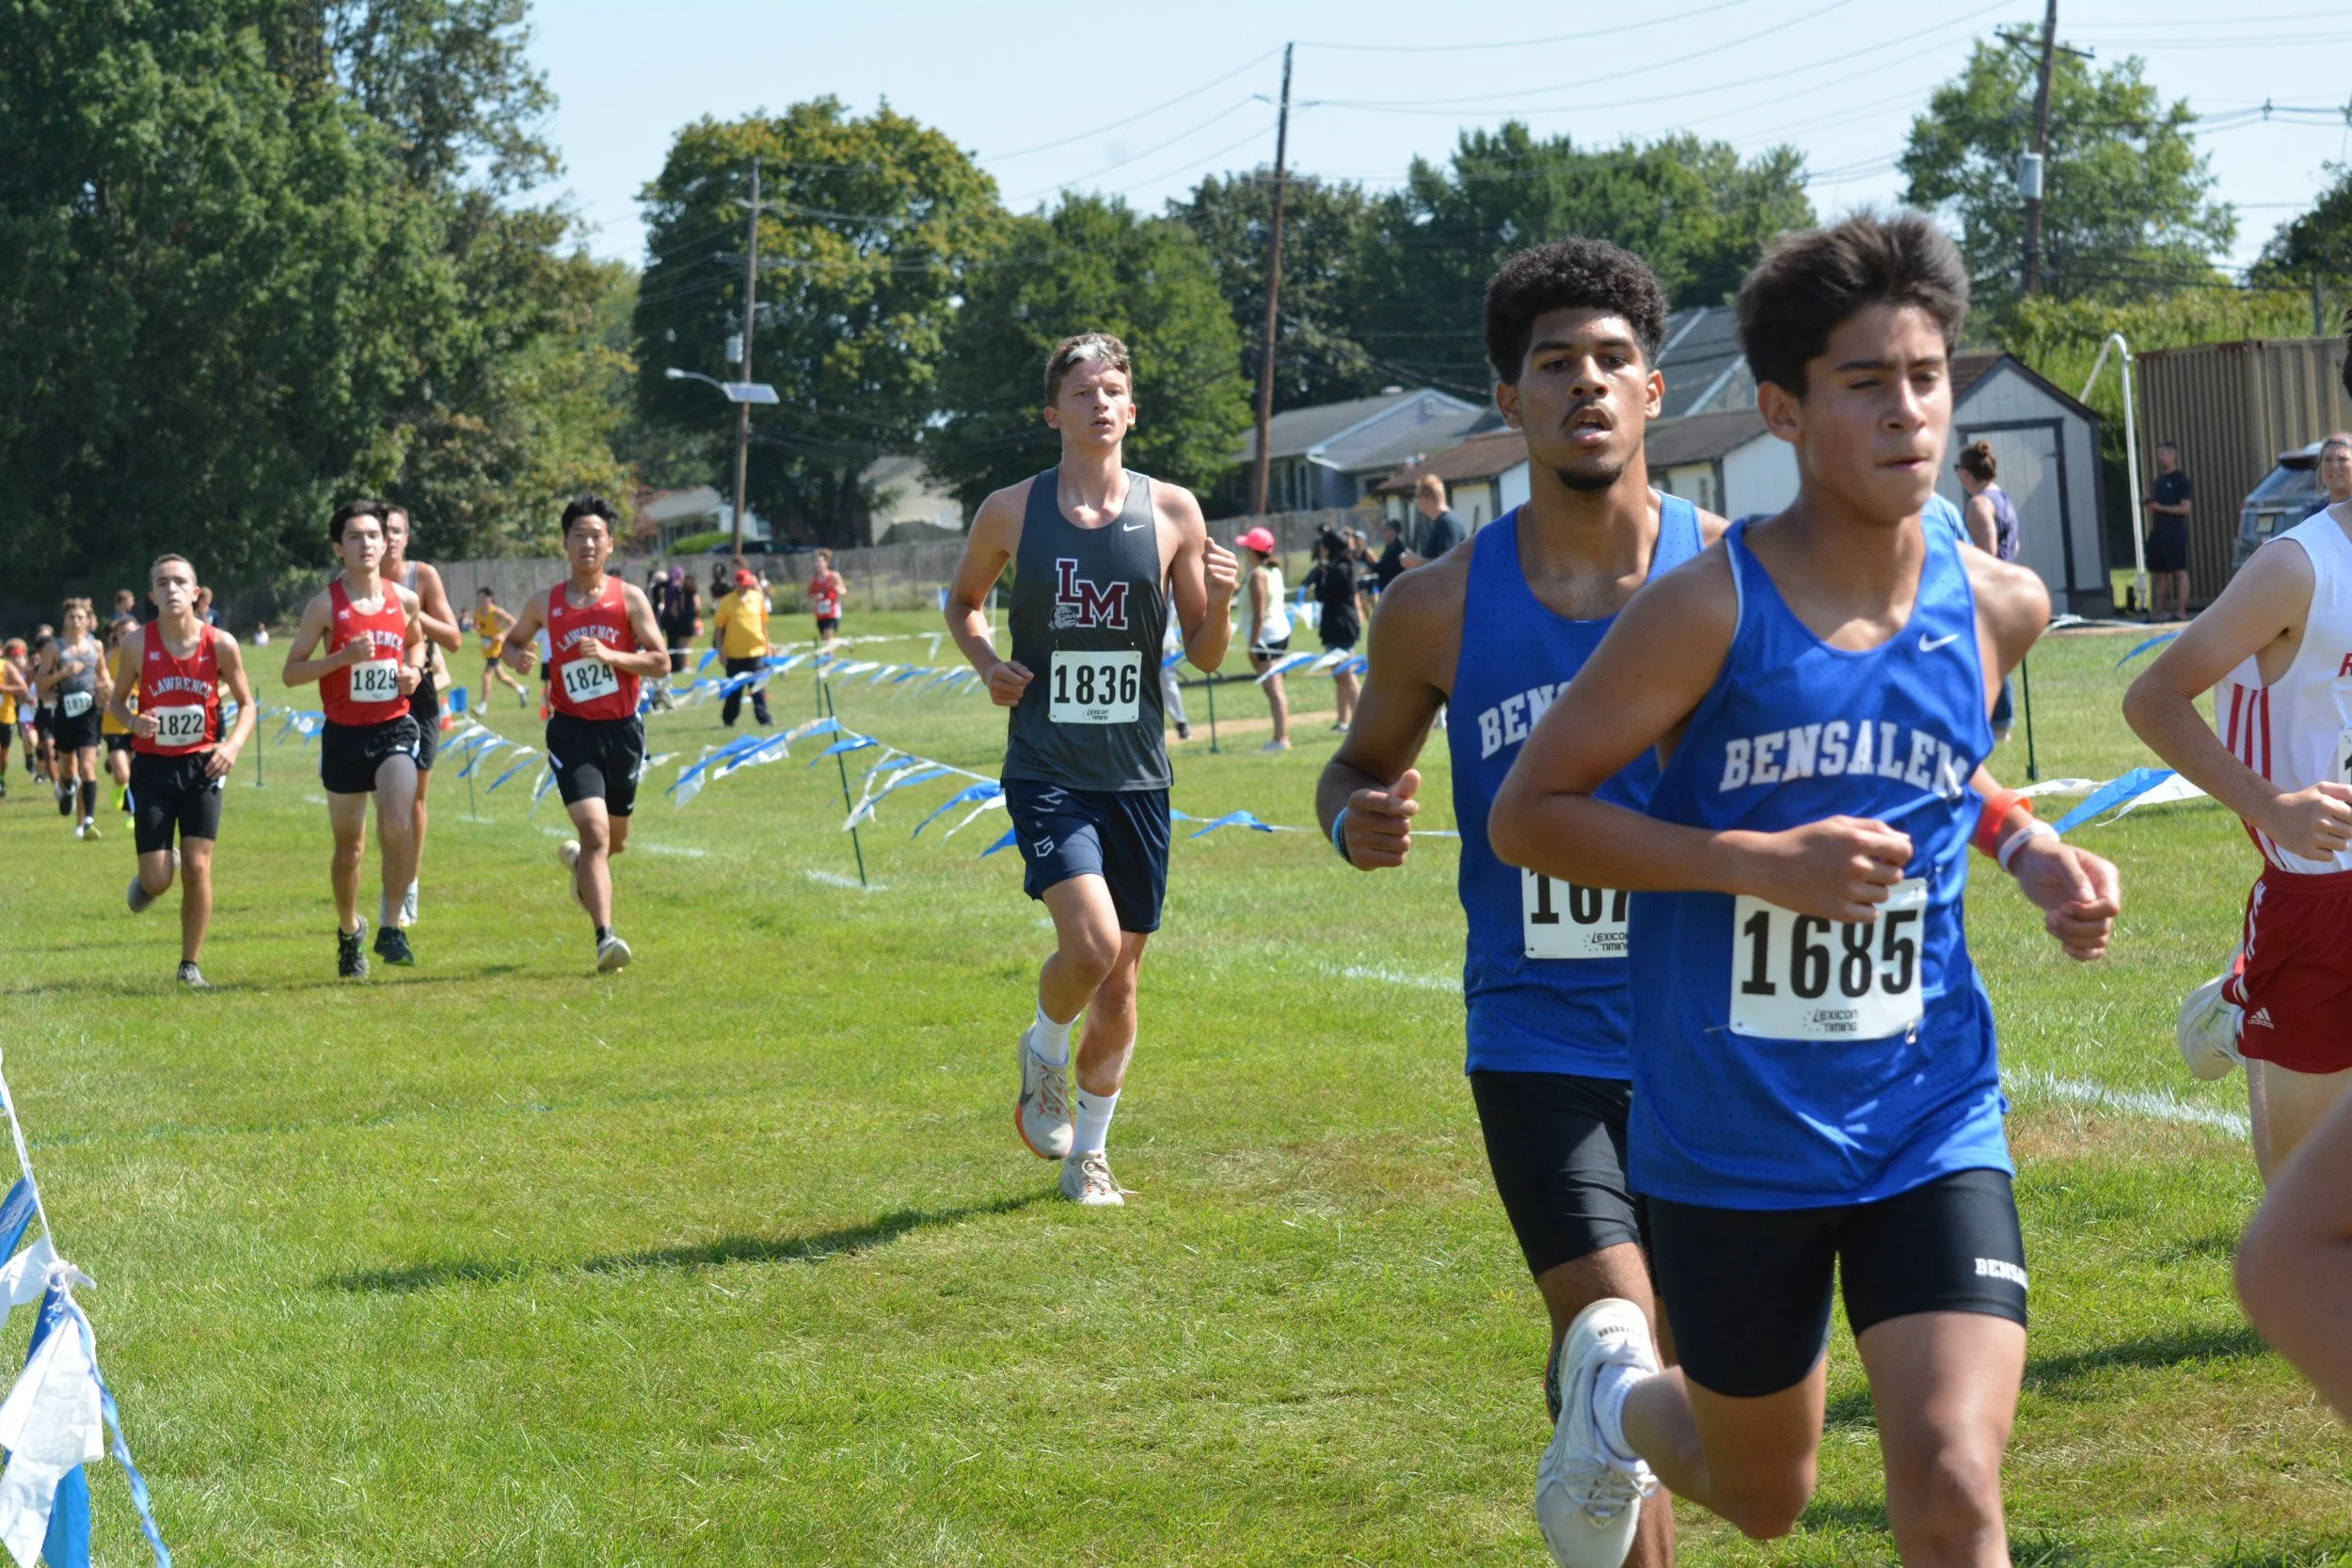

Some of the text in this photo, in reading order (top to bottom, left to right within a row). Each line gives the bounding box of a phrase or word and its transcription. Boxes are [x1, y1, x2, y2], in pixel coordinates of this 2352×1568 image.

[1056, 558, 1129, 630] LM
[556, 625, 620, 652] LAWRENCE
[149, 676, 214, 698] LAWRENCE
[354, 669, 397, 690] 1829
[565, 664, 613, 693] 1824
[1055, 665, 1137, 705] 1836
[157, 714, 202, 735] 1822
[1478, 681, 1572, 760] BEN
[1741, 909, 1918, 999] 1685
